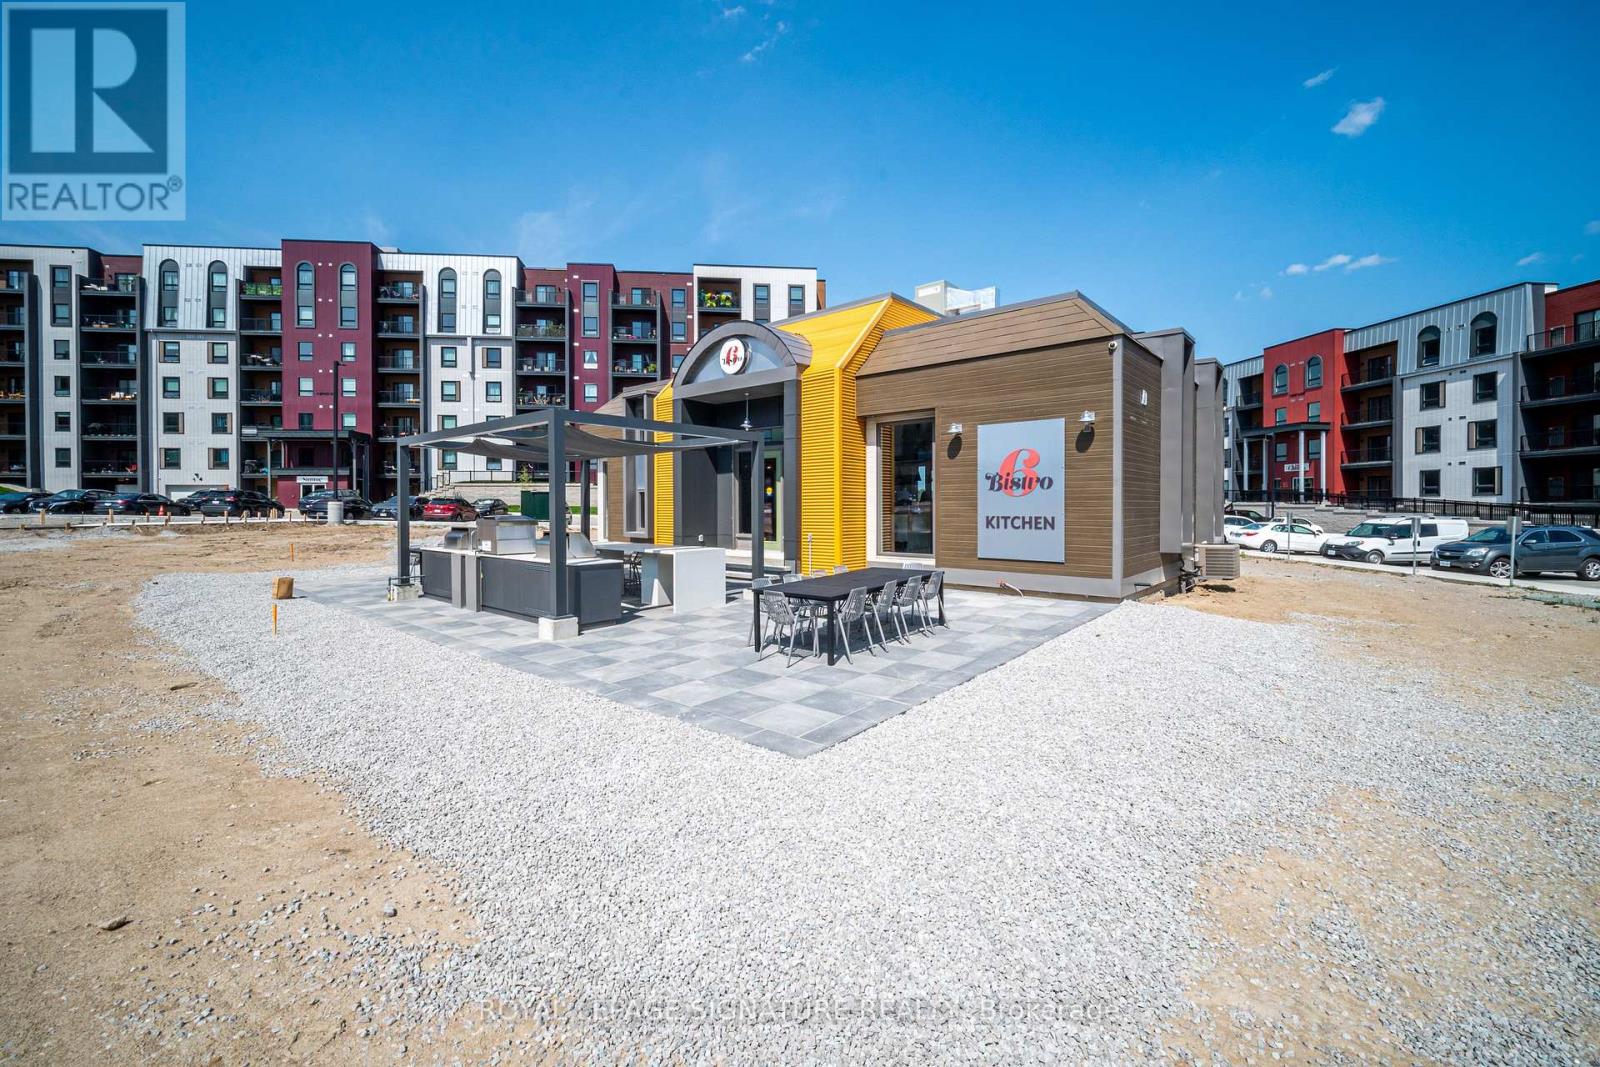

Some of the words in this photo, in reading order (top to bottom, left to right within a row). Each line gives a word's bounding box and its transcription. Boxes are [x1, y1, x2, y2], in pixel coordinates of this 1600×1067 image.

[985, 472, 1054, 493] Bistro
[998, 447, 1041, 498] 6
[985, 515, 1056, 531] KITCHEN
